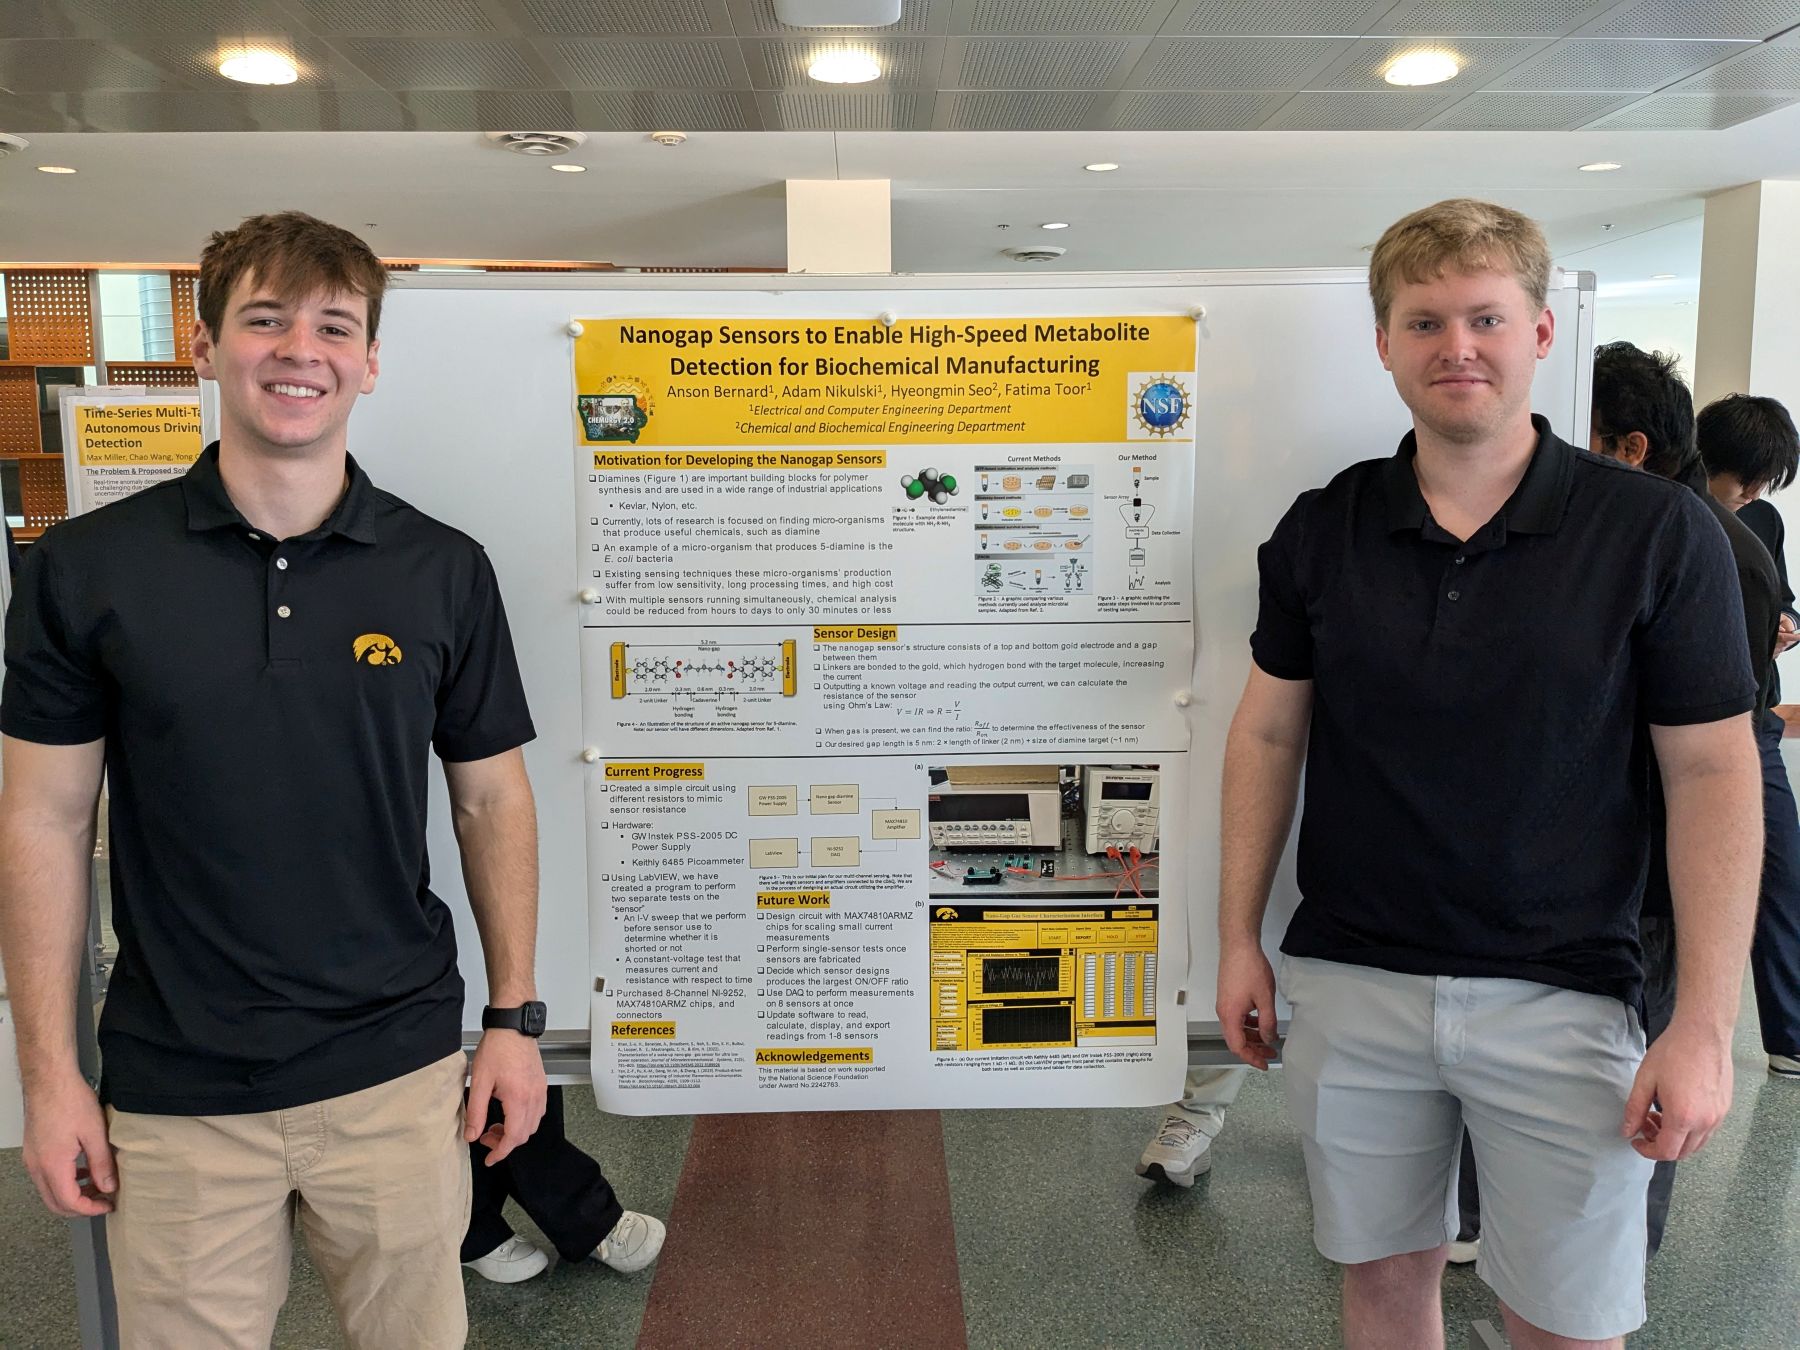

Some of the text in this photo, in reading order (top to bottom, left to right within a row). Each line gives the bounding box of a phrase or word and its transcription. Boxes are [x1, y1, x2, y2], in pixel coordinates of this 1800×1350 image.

[620, 322, 1150, 349] Nanogap Sensors to Enable High-Speed Metabolite
[671, 354, 1100, 378] Detection for Biochemical Manufacturing
[666, 385, 710, 398] Anson
[782, 384, 821, 398] Adam
[891, 384, 965, 400] Hyeongmin
[1005, 383, 1051, 396] Fatima
[804, 405, 826, 416] and
[827, 405, 880, 416] Computer
[882, 404, 944, 417] Engineering
[947, 404, 1012, 416] Department
[1143, 398, 1181, 414] NSF
[84, 408, 152, 418] Time-Series
[85, 424, 160, 433] Autonomous
[794, 422, 817, 434] and
[818, 421, 886, 433] Biochemical
[888, 421, 955, 435] Engineering
[957, 420, 1026, 434] Department
[86, 438, 142, 448] Detection
[150, 454, 174, 462] Wang,
[176, 453, 193, 462] Yong
[594, 453, 882, 468] Motivation for Developing the Nanogap Sensors
[138, 468, 171, 476] Proposed
[598, 474, 641, 483] Diamines
[643, 474, 676, 485] (Figure
[680, 474, 689, 484] 1)
[708, 474, 748, 484] important
[750, 473, 785, 484] building
[788, 473, 817, 482] blocks
[819, 473, 831, 482] for
[833, 473, 869, 483] polymer
[651, 501, 678, 512] Nylon,
[604, 554, 673, 563] E. coli bacteria
[606, 607, 631, 615] could
[633, 607, 645, 615] be
[648, 606, 685, 615] reduced
[687, 606, 708, 615] from
[711, 606, 736, 615] hours
[739, 606, 748, 615] to
[750, 606, 772, 616] days
[775, 606, 784, 615] to
[786, 606, 806, 616] only
[808, 606, 820, 614] 30
[873, 605, 892, 614] less
[814, 628, 896, 640] Sensor Design
[605, 766, 703, 779] Current Progress
[609, 784, 642, 792] Created
[654, 784, 683, 793] simple
[712, 784, 736, 794] using
[612, 821, 654, 829] Hardware:
[631, 831, 738, 841] GW Instek PSS-2005 DC
[632, 842, 691, 852] Power Supply
[632, 857, 745, 868] Keithly 6485 Picoammeter
[757, 894, 830, 905] Future Work
[766, 911, 914, 922] Design circuit with MAX74810ARMZ
[766, 1010, 796, 1020] Update
[798, 1010, 835, 1019] software
[848, 1011, 869, 1019] read,
[611, 1024, 675, 1035] References
[756, 1050, 870, 1064] Acknowledgements
